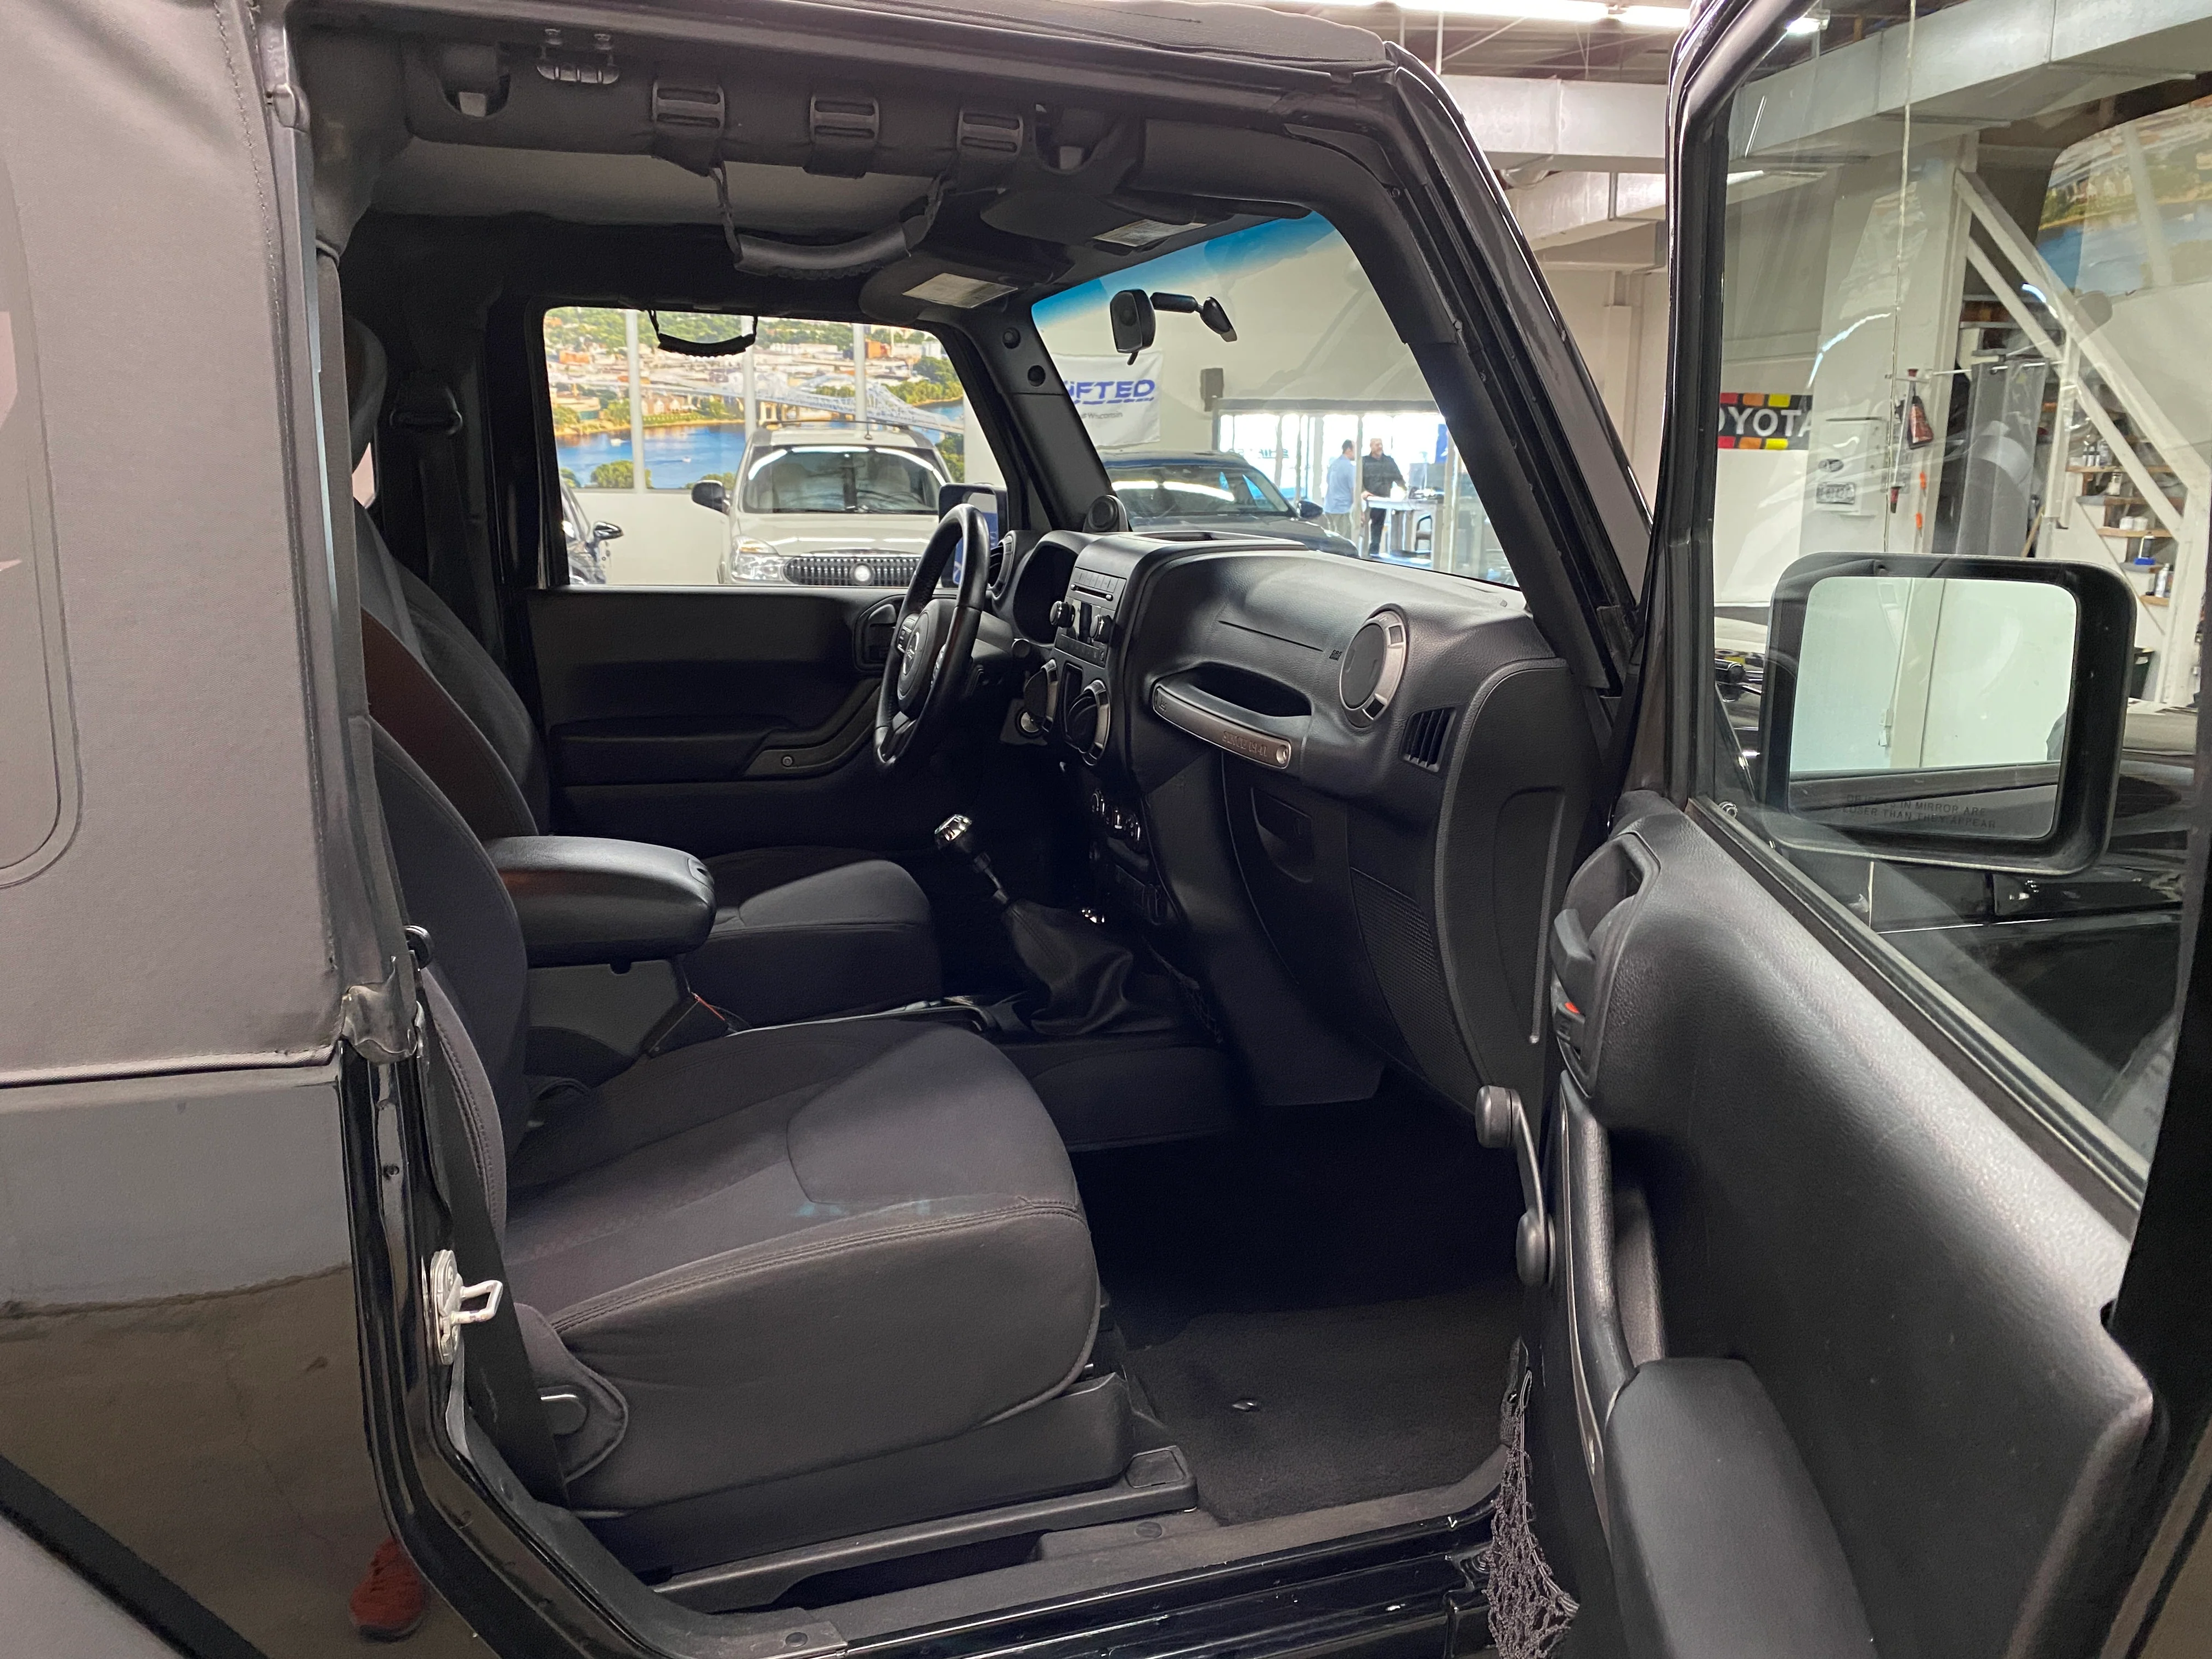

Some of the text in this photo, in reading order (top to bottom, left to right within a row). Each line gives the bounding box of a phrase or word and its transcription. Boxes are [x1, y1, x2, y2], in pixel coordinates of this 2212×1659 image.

[1719, 407, 1812, 437] YOTA
[1222, 731, 1267, 757] SINCE 1941
[1841, 806, 1996, 828] LOSER THAN THEY APPEAR
[1900, 800, 1911, 809] IN
[1915, 802, 1958, 814] MIRROR
[1963, 806, 1987, 816] ARE
